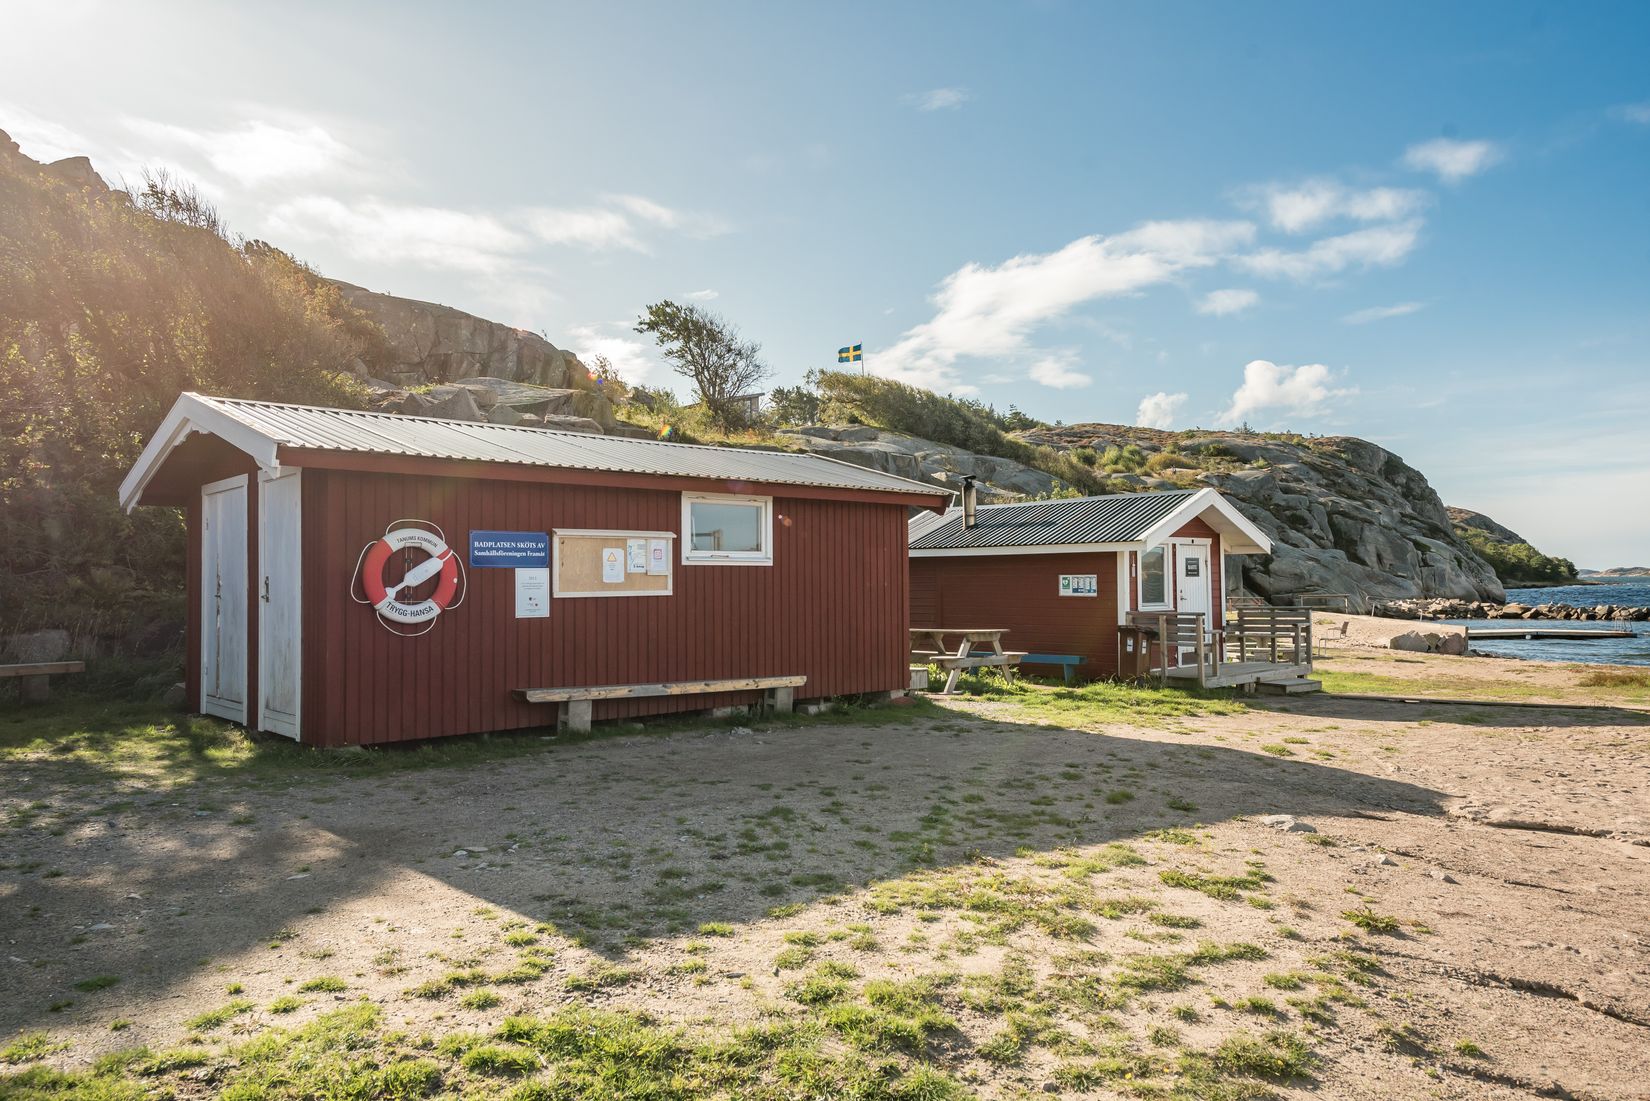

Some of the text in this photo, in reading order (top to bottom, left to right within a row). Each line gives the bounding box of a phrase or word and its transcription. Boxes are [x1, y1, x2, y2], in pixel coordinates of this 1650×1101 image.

[397, 535, 438, 548] TANUMS KOMMUN
[474, 541, 516, 549] BADPLATSEN
[517, 541, 536, 549] SKÖTS
[474, 550, 526, 558] Samhällsföreningen
[386, 602, 434, 617] TRYGG-HANSA
